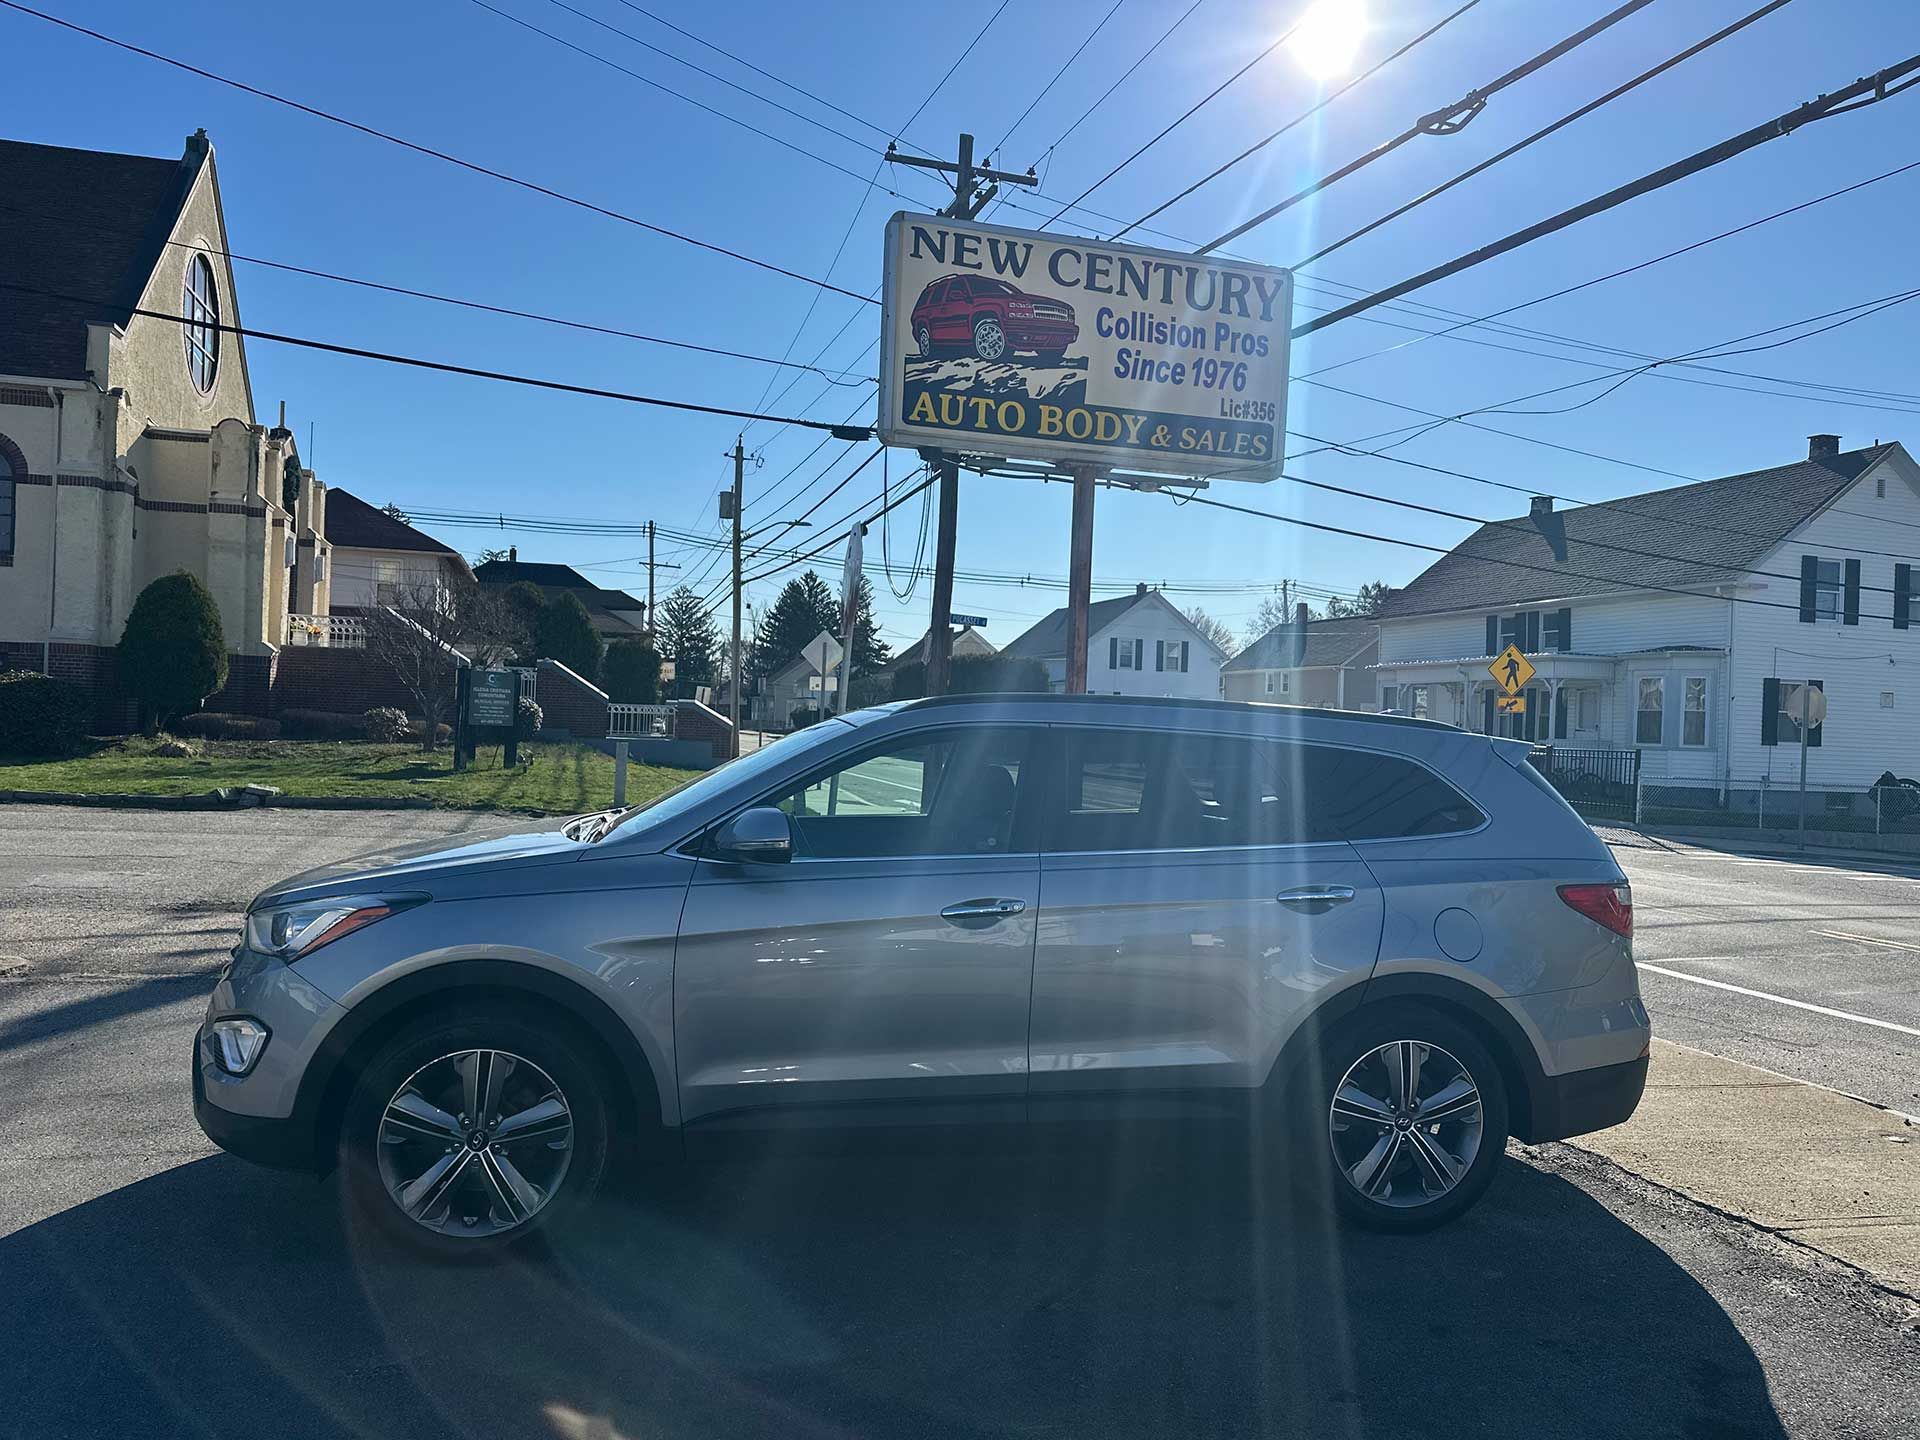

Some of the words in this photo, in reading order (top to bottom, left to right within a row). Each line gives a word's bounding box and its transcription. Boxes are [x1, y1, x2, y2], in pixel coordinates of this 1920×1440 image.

[909, 225, 1034, 278] NEW
[1048, 248, 1284, 323] CENTURY
[1096, 306, 1207, 349] Collision
[1214, 321, 1269, 358] Pros
[1114, 348, 1186, 386] Since
[1192, 357, 1248, 392] 1976
[908, 391, 1025, 432] AUTO
[1038, 404, 1147, 445] BODY
[1150, 424, 1173, 447] &
[1178, 427, 1268, 458] SALES
[1219, 397, 1276, 422] Lic#356
